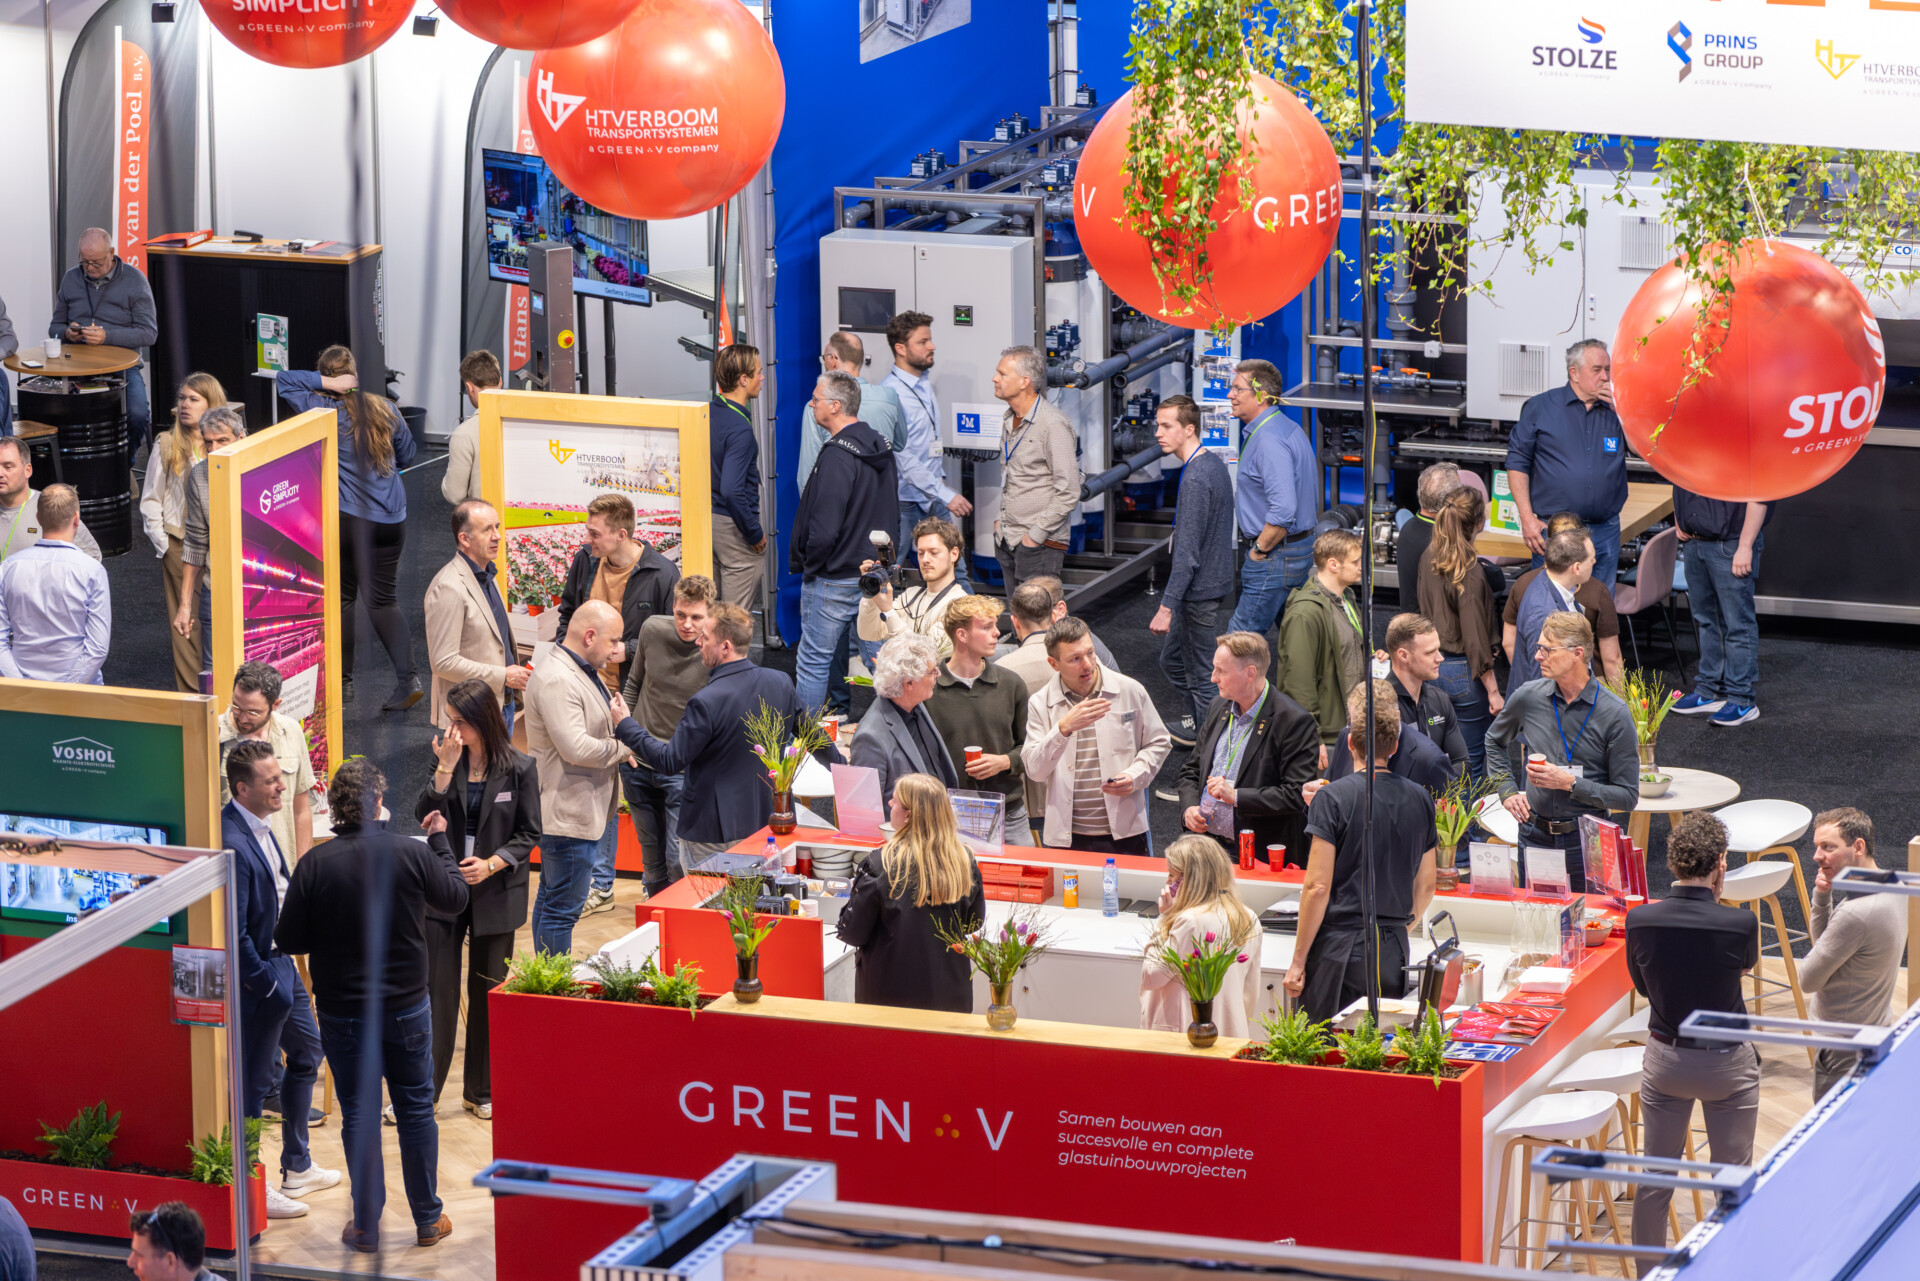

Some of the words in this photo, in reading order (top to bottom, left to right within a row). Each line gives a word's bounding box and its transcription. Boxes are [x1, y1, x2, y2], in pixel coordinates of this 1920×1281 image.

[247, 23, 294, 33] GREEN
[305, 25, 315, 33] V
[319, 20, 375, 32] company
[1704, 34, 1758, 50] PRINS
[133, 55, 143, 81] B.V.
[1532, 46, 1618, 70] STOLZE
[1704, 53, 1763, 69] GROUP
[126, 90, 142, 144] Poel
[586, 107, 718, 127] HTVERBOOM
[587, 126, 719, 139] TRANSPORTSYSTEMEN
[598, 145, 644, 154] GREEN
[655, 145, 664, 154] V
[667, 143, 719, 154] company
[124, 152, 140, 192] der
[1081, 183, 1096, 218] V
[127, 201, 140, 247] van
[514, 296, 528, 360] Hans
[1783, 379, 1885, 438] STOL
[1804, 436, 1852, 453] GREEN
[576, 454, 626, 464] HTVERBOOM
[272, 479, 289, 494] GREEN
[52, 745, 115, 763] VOSHOL
[679, 1081, 910, 1143] GREEN
[976, 1107, 1014, 1151] V
[1058, 1110, 1115, 1128] Samen
[1120, 1115, 1185, 1135] bouwen
[1189, 1125, 1222, 1138] aan
[1058, 1132, 1148, 1151] succesvolle
[1152, 1141, 1172, 1153] en
[1176, 1144, 1254, 1161] complete
[1058, 1149, 1247, 1180] glastuinbouwprojecten
[23, 1187, 104, 1211] GREEN
[124, 1198, 138, 1214] V
